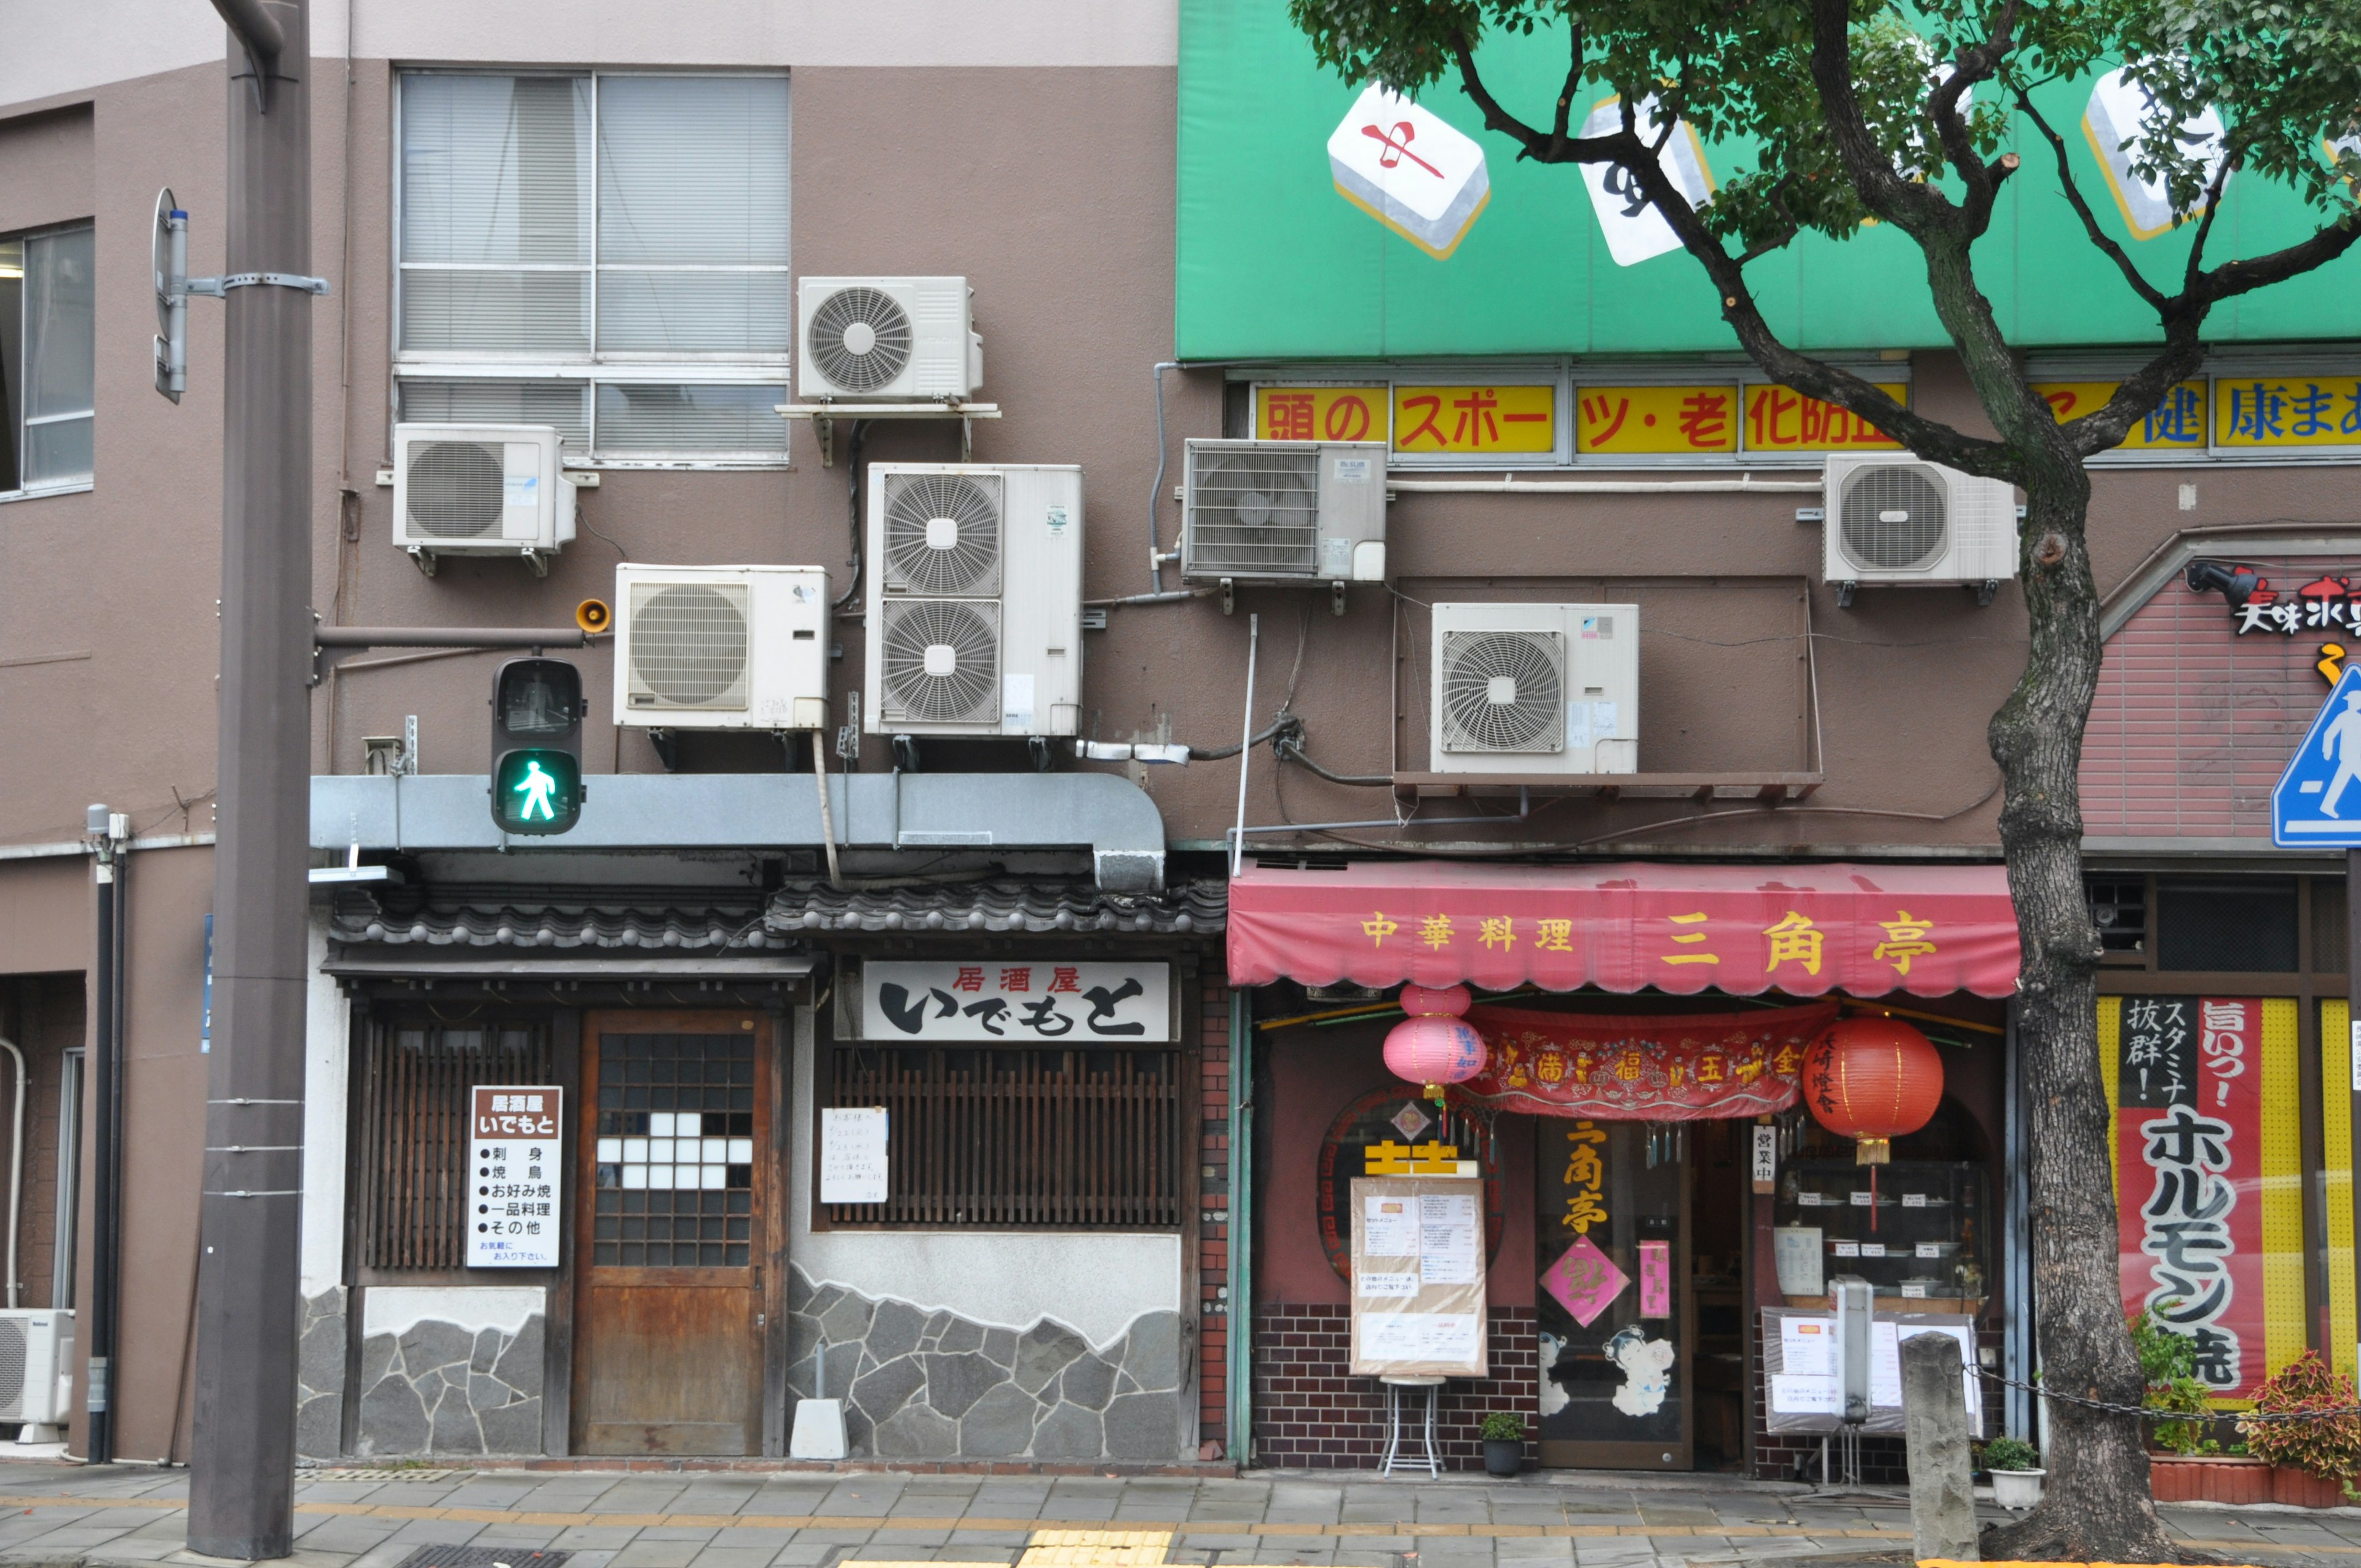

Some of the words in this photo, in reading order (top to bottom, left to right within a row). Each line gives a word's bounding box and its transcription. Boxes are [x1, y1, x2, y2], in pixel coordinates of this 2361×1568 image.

[1360, 911, 1573, 952] 中華料理
[1661, 910, 1937, 976] 三角亭
[952, 967, 1082, 993] 居酒屋
[879, 978, 1145, 1036] いでもと
[2161, 1000, 2187, 1104] スタミナ
[491, 1095, 544, 1112] 居酒屋
[480, 1115, 554, 1134] いでもと
[1757, 1133, 1771, 1180] 営業中
[492, 1184, 552, 1198] お好み焼
[491, 1202, 551, 1217] 一品料理
[491, 1221, 540, 1235] その他
